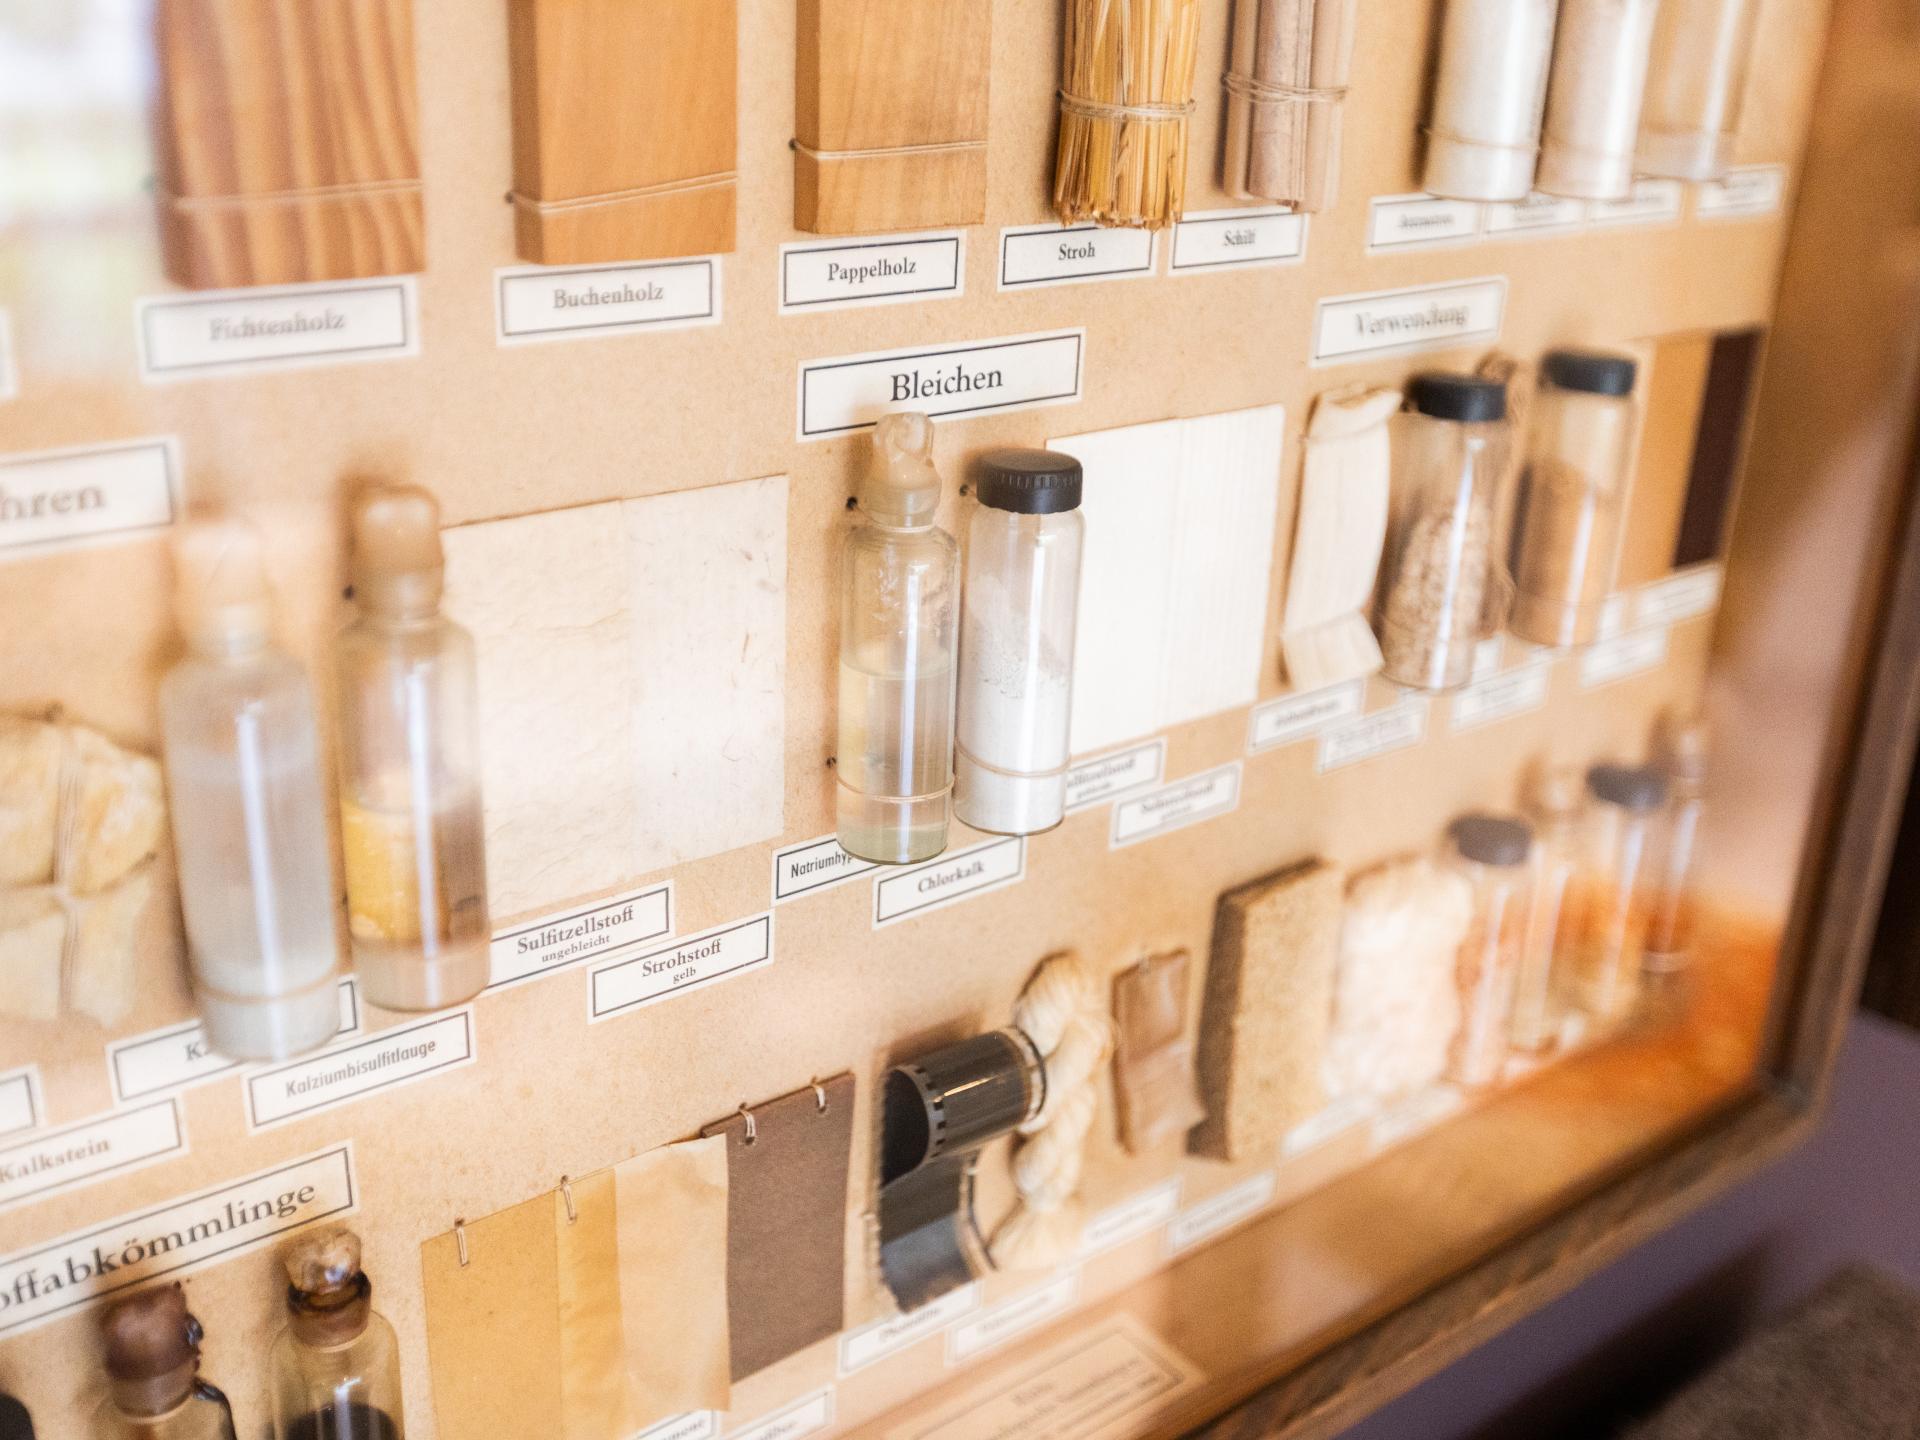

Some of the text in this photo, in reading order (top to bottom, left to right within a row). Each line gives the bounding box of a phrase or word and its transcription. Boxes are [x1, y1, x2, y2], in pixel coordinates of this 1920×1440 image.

[1057, 241, 1096, 261] Stroh
[827, 258, 917, 283] Pappelholz
[553, 282, 664, 310] Buchenholz
[209, 310, 346, 342] Fichtenholz
[890, 365, 1003, 402] Bleichen
[917, 861, 985, 893] Chlorkalk
[517, 905, 634, 955] Sulfitzellstoff
[541, 933, 611, 963] ungebleicht
[641, 939, 721, 978] Strohstoff
[673, 967, 696, 984] gelb
[285, 1040, 436, 1097] Kalziumbisulfitlauge
[0, 1137, 111, 1184] Kalkstein
